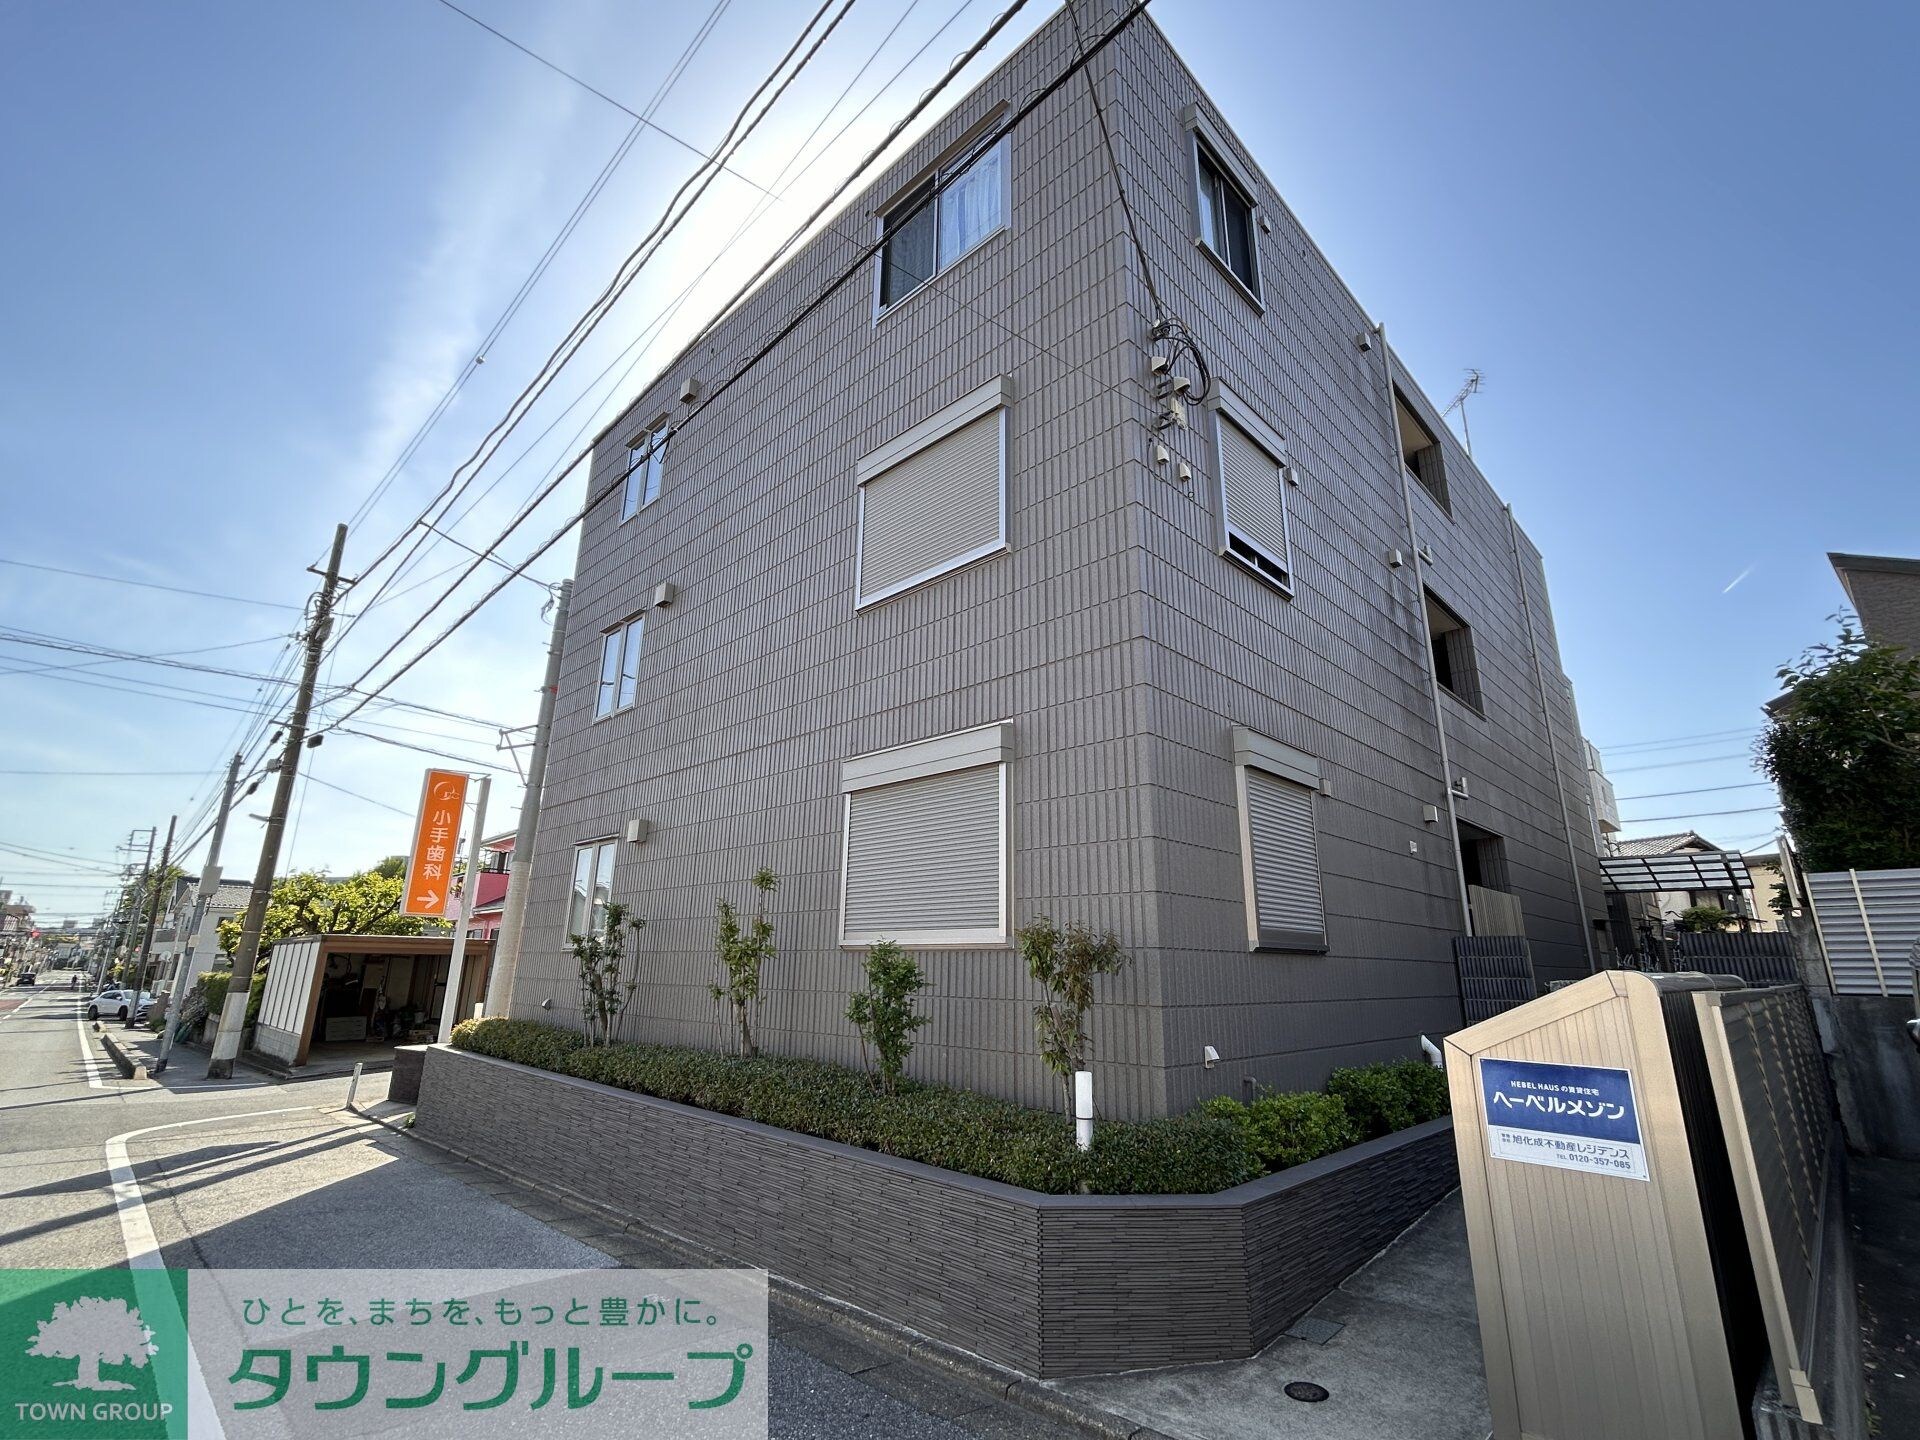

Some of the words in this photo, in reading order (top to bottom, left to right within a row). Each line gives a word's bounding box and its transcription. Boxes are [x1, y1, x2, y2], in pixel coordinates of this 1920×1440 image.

[423, 809, 451, 880] 小手歯科
[1510, 1080, 1536, 1090] HEBEL
[1538, 1083, 1559, 1092] HAUS
[1493, 1091, 1625, 1120] ヘーベルメゾン
[1512, 1134, 1630, 1159] 旭化成不動産レジデンス
[1569, 1154, 1631, 1169] 0120-357-085
